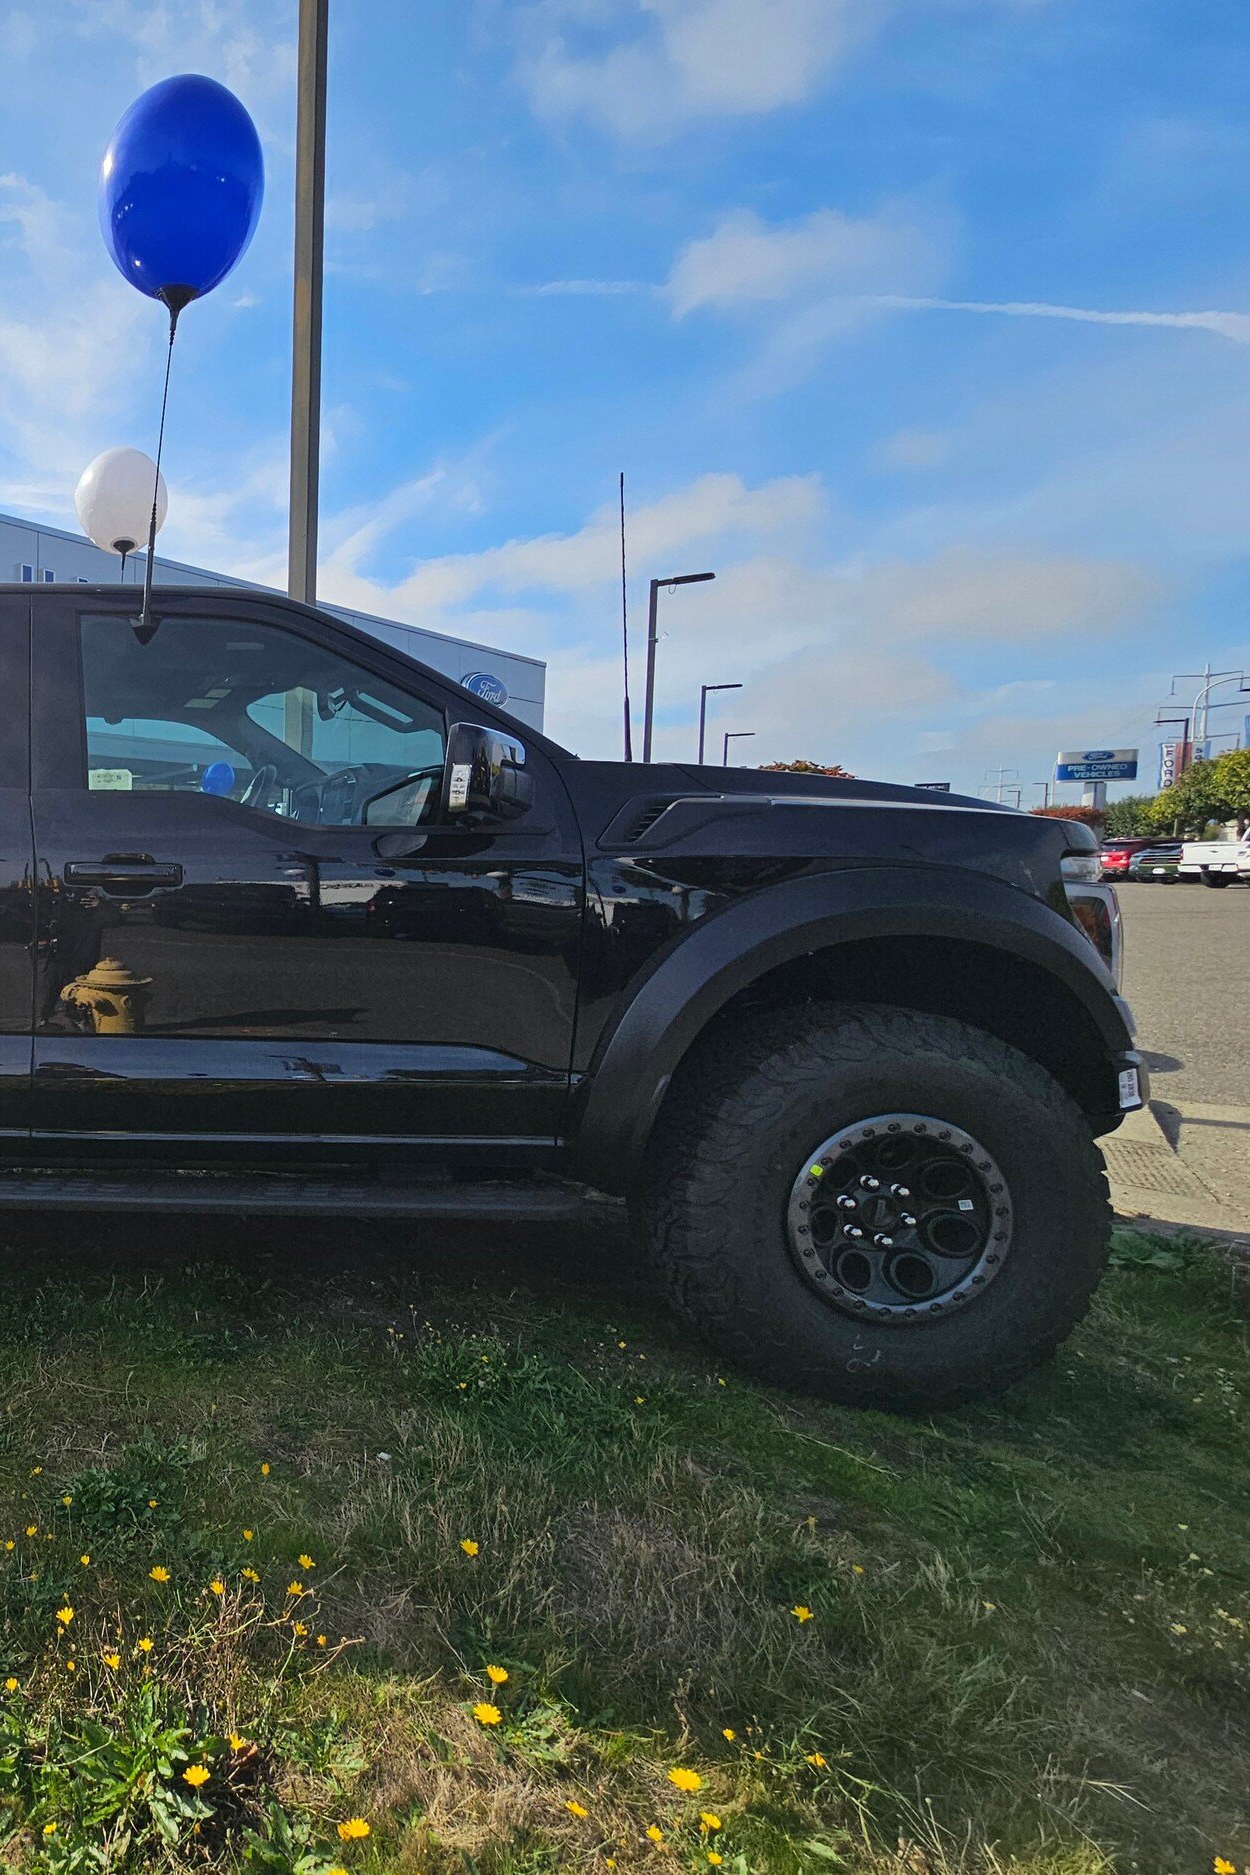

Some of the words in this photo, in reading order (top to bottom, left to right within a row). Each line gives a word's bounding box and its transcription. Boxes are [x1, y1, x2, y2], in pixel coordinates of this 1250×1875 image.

[477, 680, 502, 703] Ford
[1073, 770, 1122, 778] VEHICLES
[1163, 749, 1174, 788] FORD
